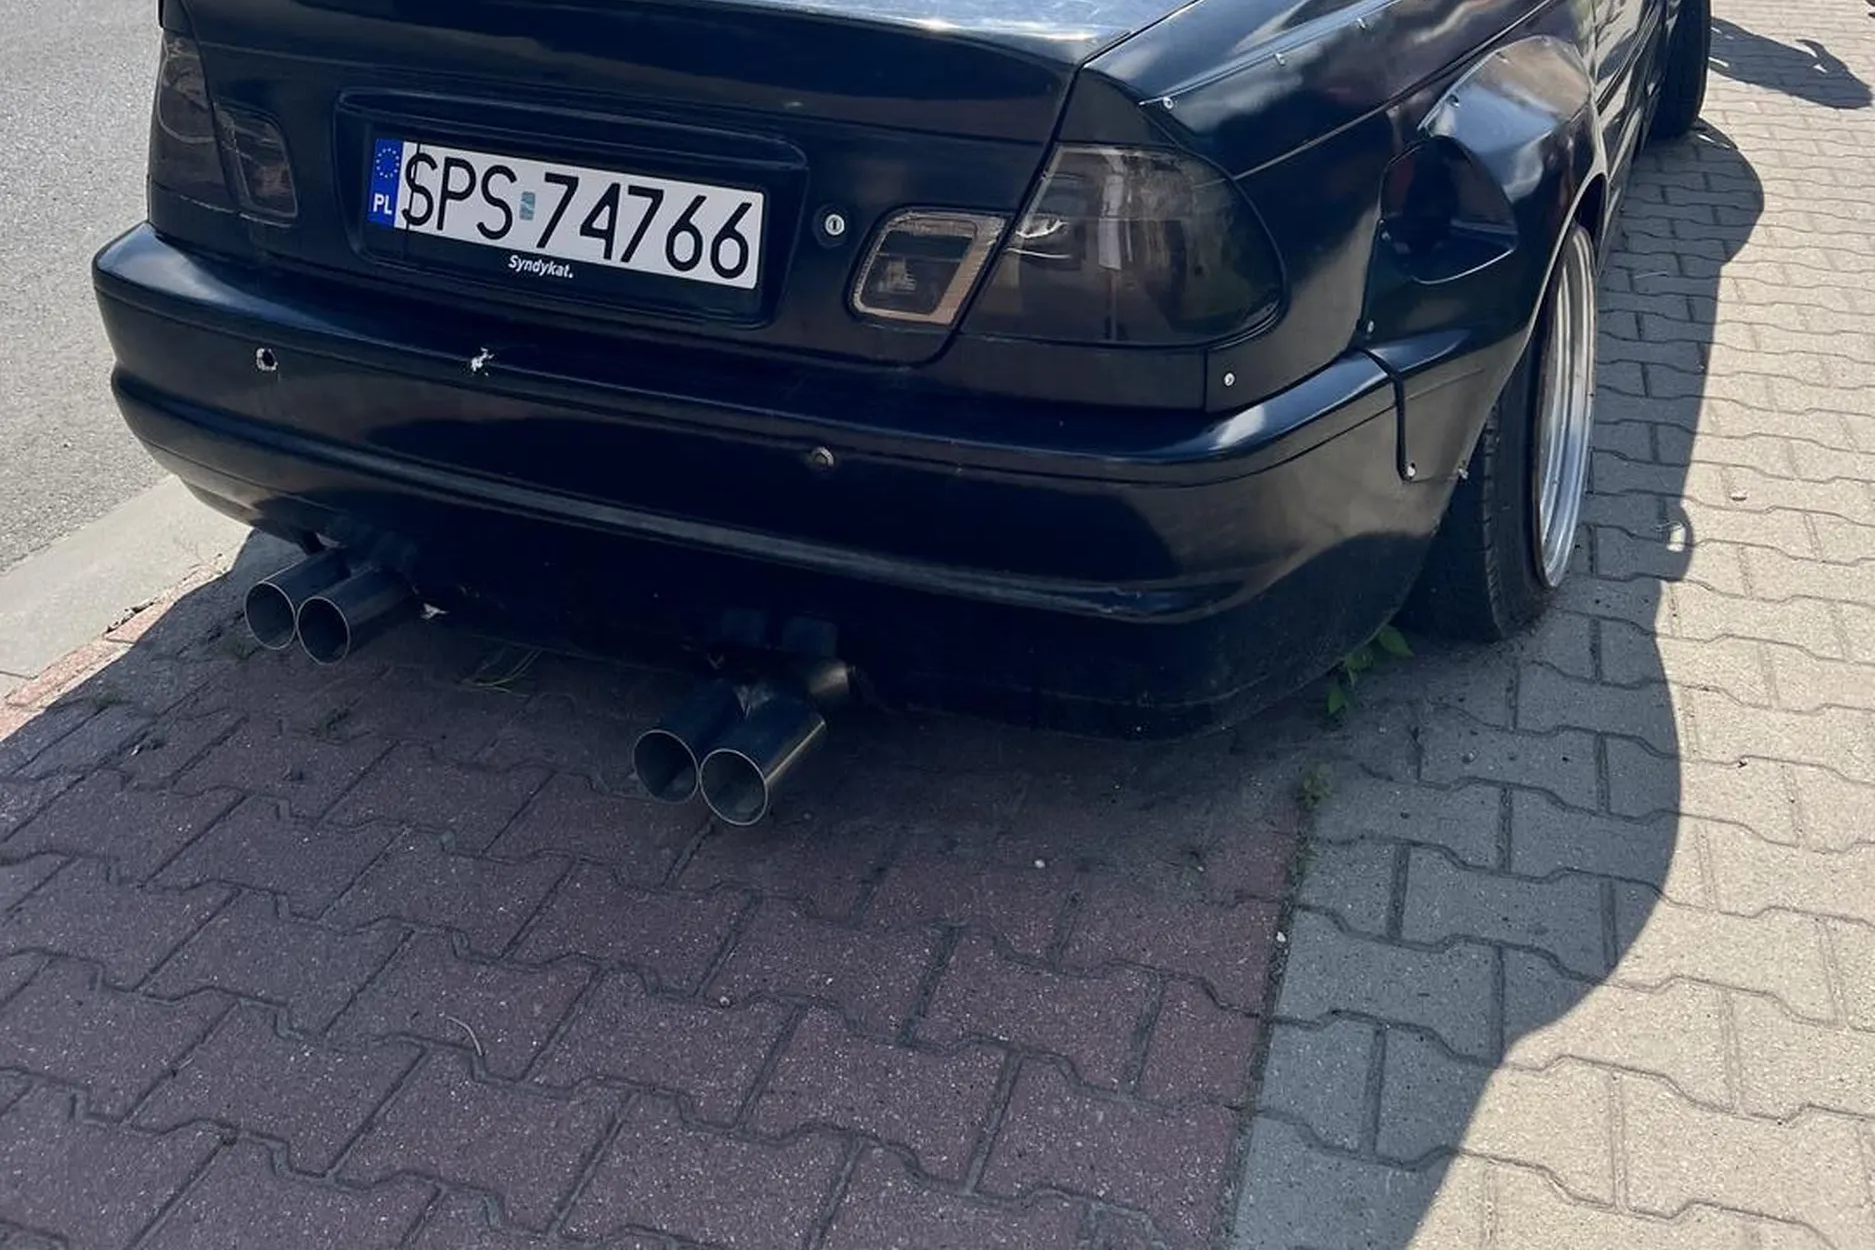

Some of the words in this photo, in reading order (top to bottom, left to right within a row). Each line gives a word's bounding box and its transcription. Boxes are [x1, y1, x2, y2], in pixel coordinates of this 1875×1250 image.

[372, 193, 393, 216] PL
[401, 152, 518, 240] SPS
[536, 172, 753, 280] 74766
[508, 254, 574, 279] Syndykat.
